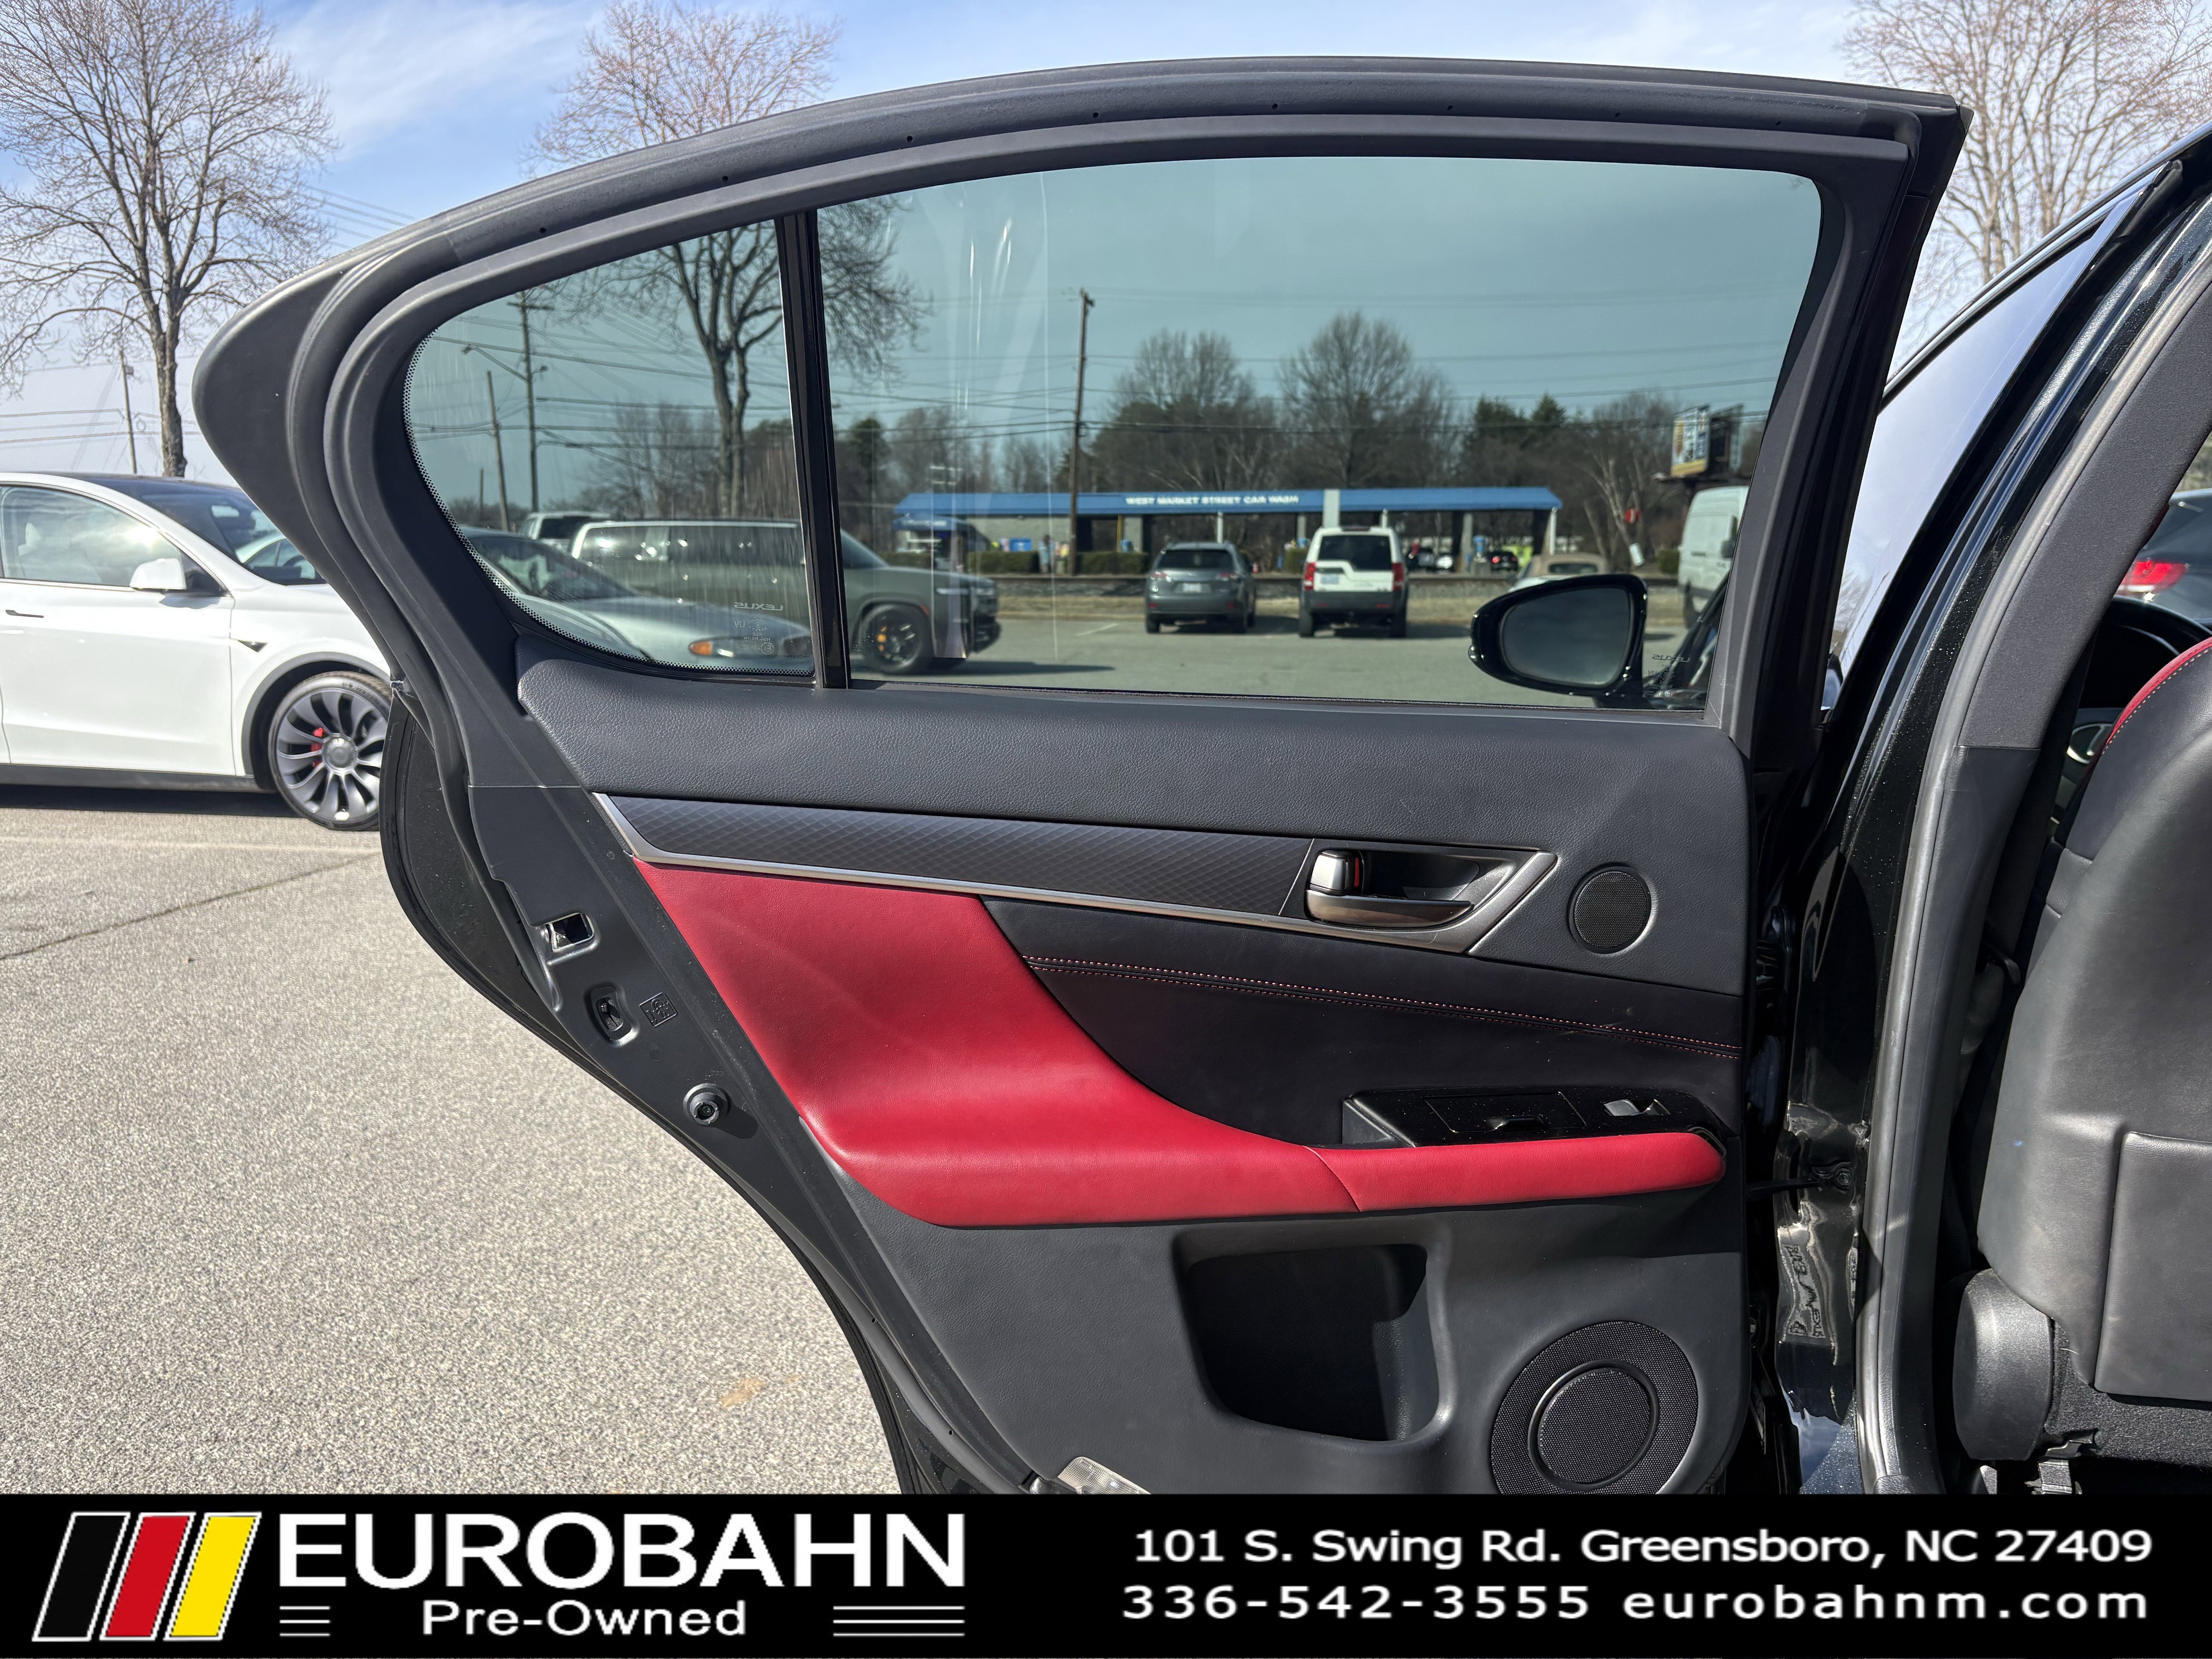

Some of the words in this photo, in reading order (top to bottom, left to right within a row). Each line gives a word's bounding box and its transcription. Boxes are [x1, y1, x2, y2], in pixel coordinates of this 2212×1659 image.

[1157, 496, 1199, 505] MARKET
[1201, 496, 1242, 504] STREET
[1243, 496, 1267, 504] CAR
[1268, 495, 1299, 503] WASH
